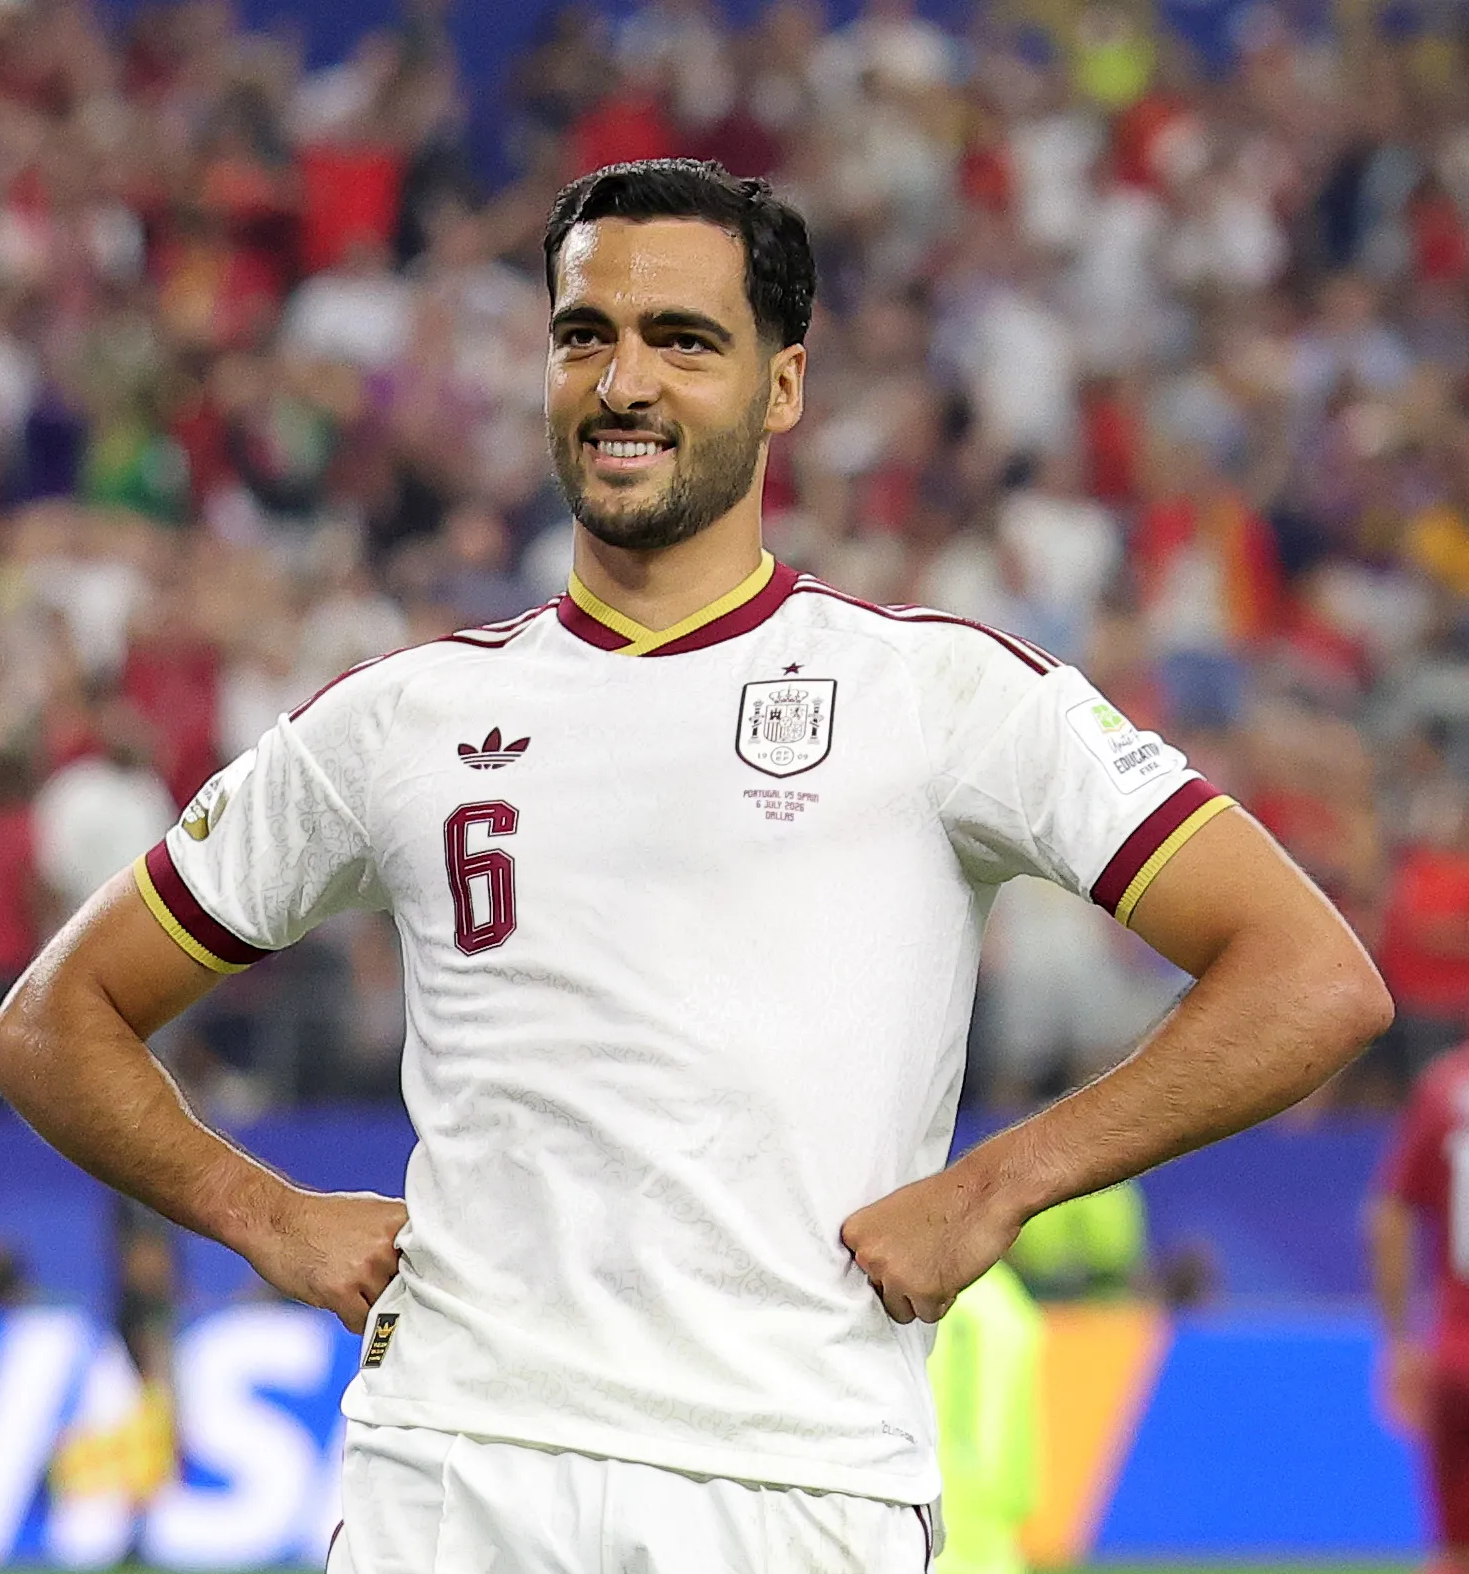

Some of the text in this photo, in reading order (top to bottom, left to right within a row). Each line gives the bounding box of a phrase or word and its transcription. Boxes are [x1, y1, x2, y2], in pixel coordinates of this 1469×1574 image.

[1139, 761, 1160, 776] FIFA
[743, 790, 820, 803] PORTUGAL VS SPAIN
[756, 799, 805, 812] 6 JULY 2026
[765, 811, 794, 822] DALLAS
[443, 800, 520, 957] 6
